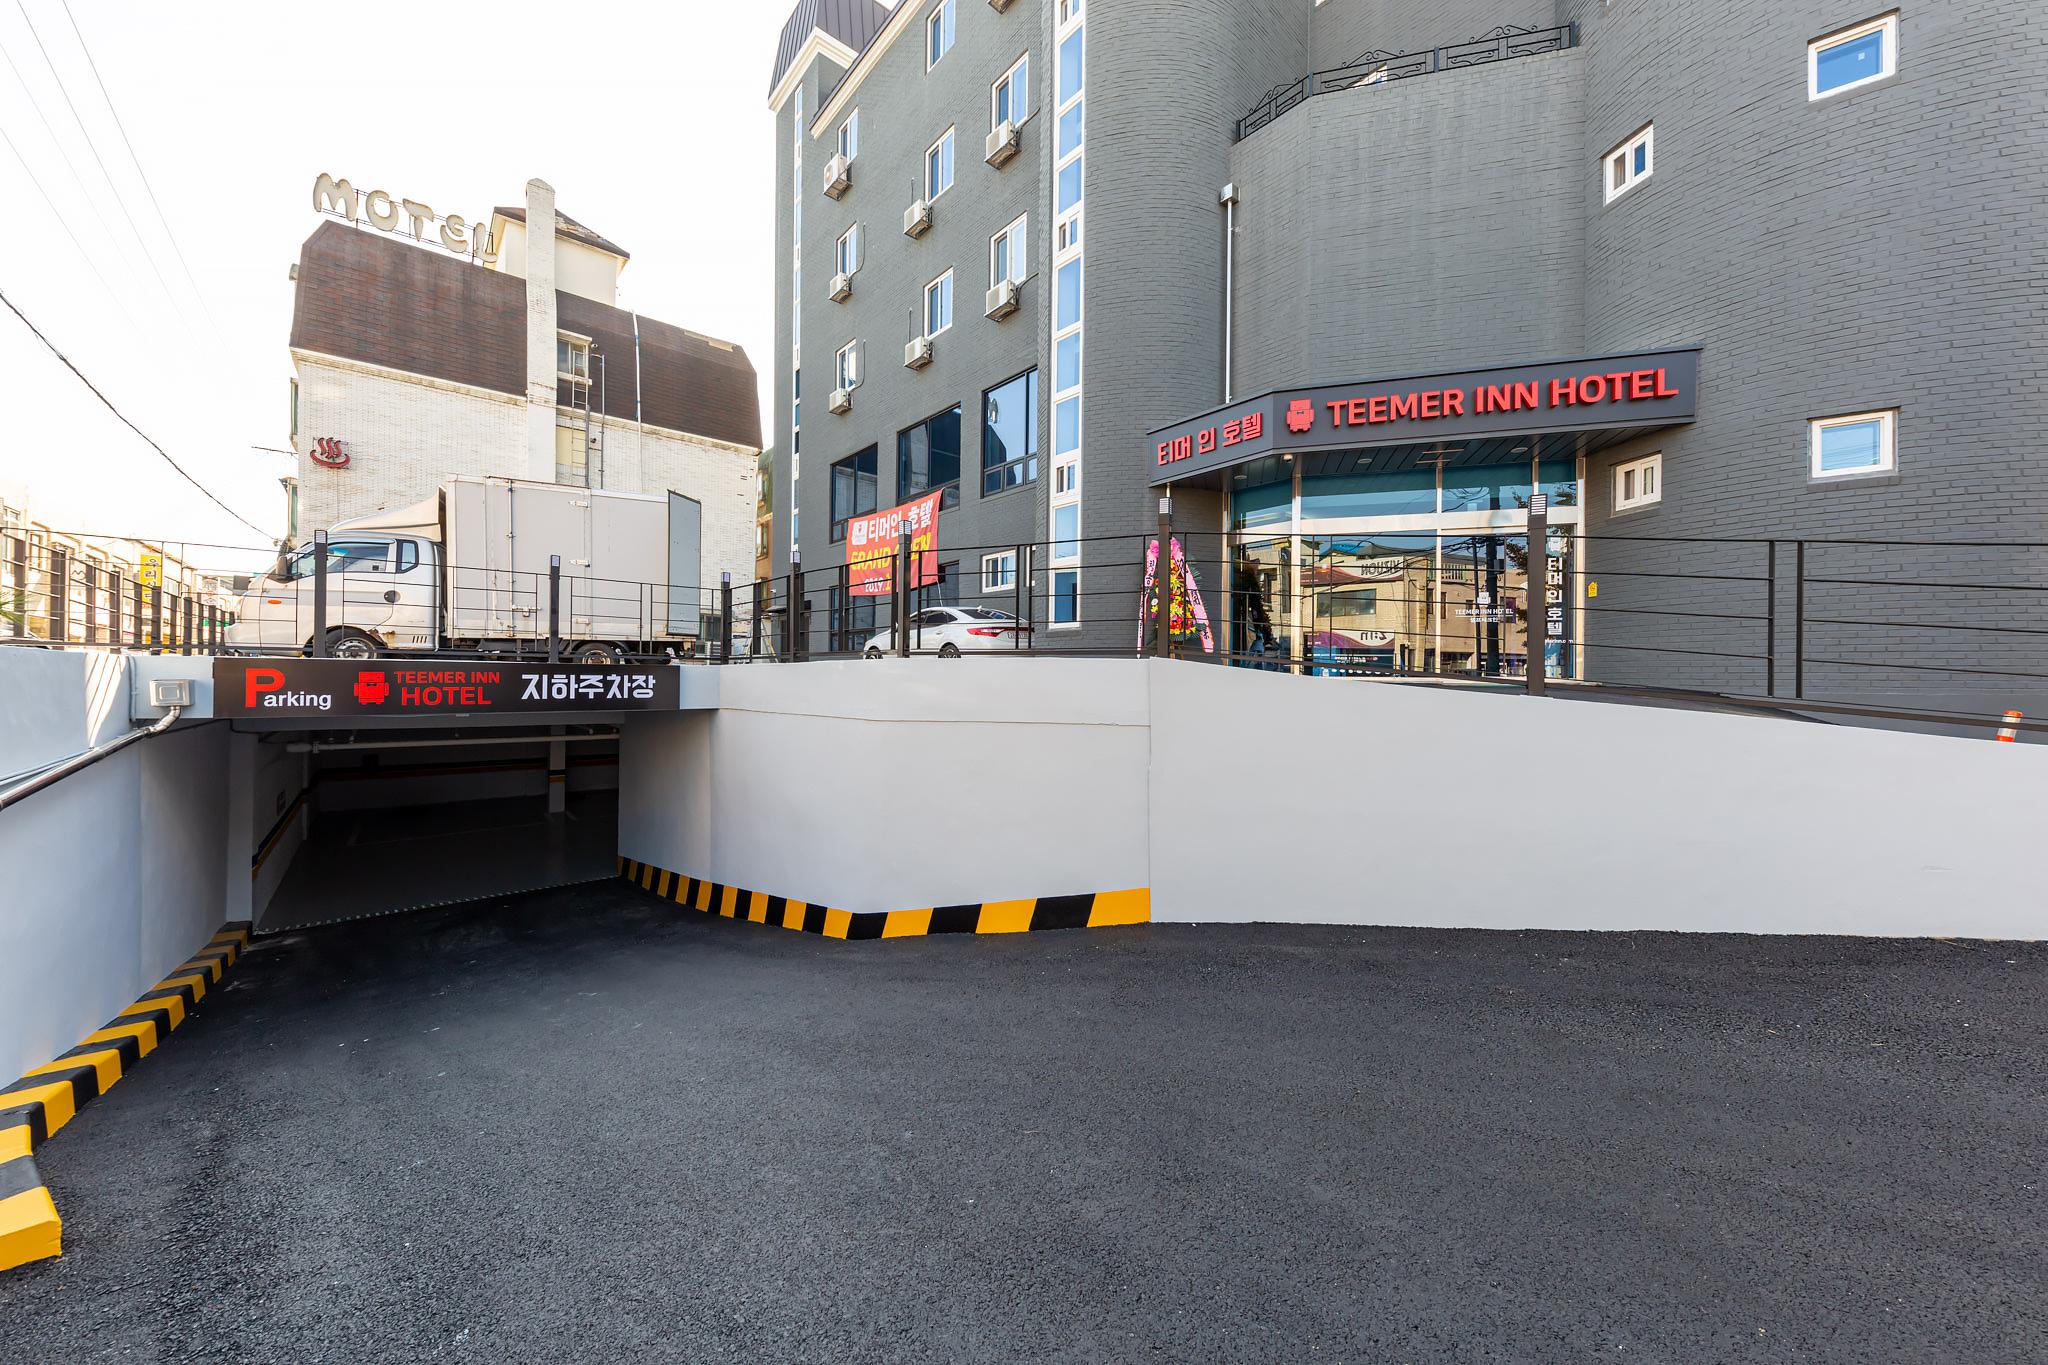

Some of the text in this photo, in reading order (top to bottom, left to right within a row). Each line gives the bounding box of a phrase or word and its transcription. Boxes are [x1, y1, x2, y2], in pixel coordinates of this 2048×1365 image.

[313, 173, 498, 263] MOTEL
[1327, 367, 1680, 428] TEEMER INN HOTEL
[1157, 412, 1263, 467] 티머 인 호텔
[907, 499, 934, 530] 호텔
[850, 546, 891, 571] GRAND
[244, 667, 332, 710] Parking
[394, 671, 501, 684] TEEMER INN
[521, 673, 656, 700] 지하주차장
[401, 686, 492, 706] HOTEL
